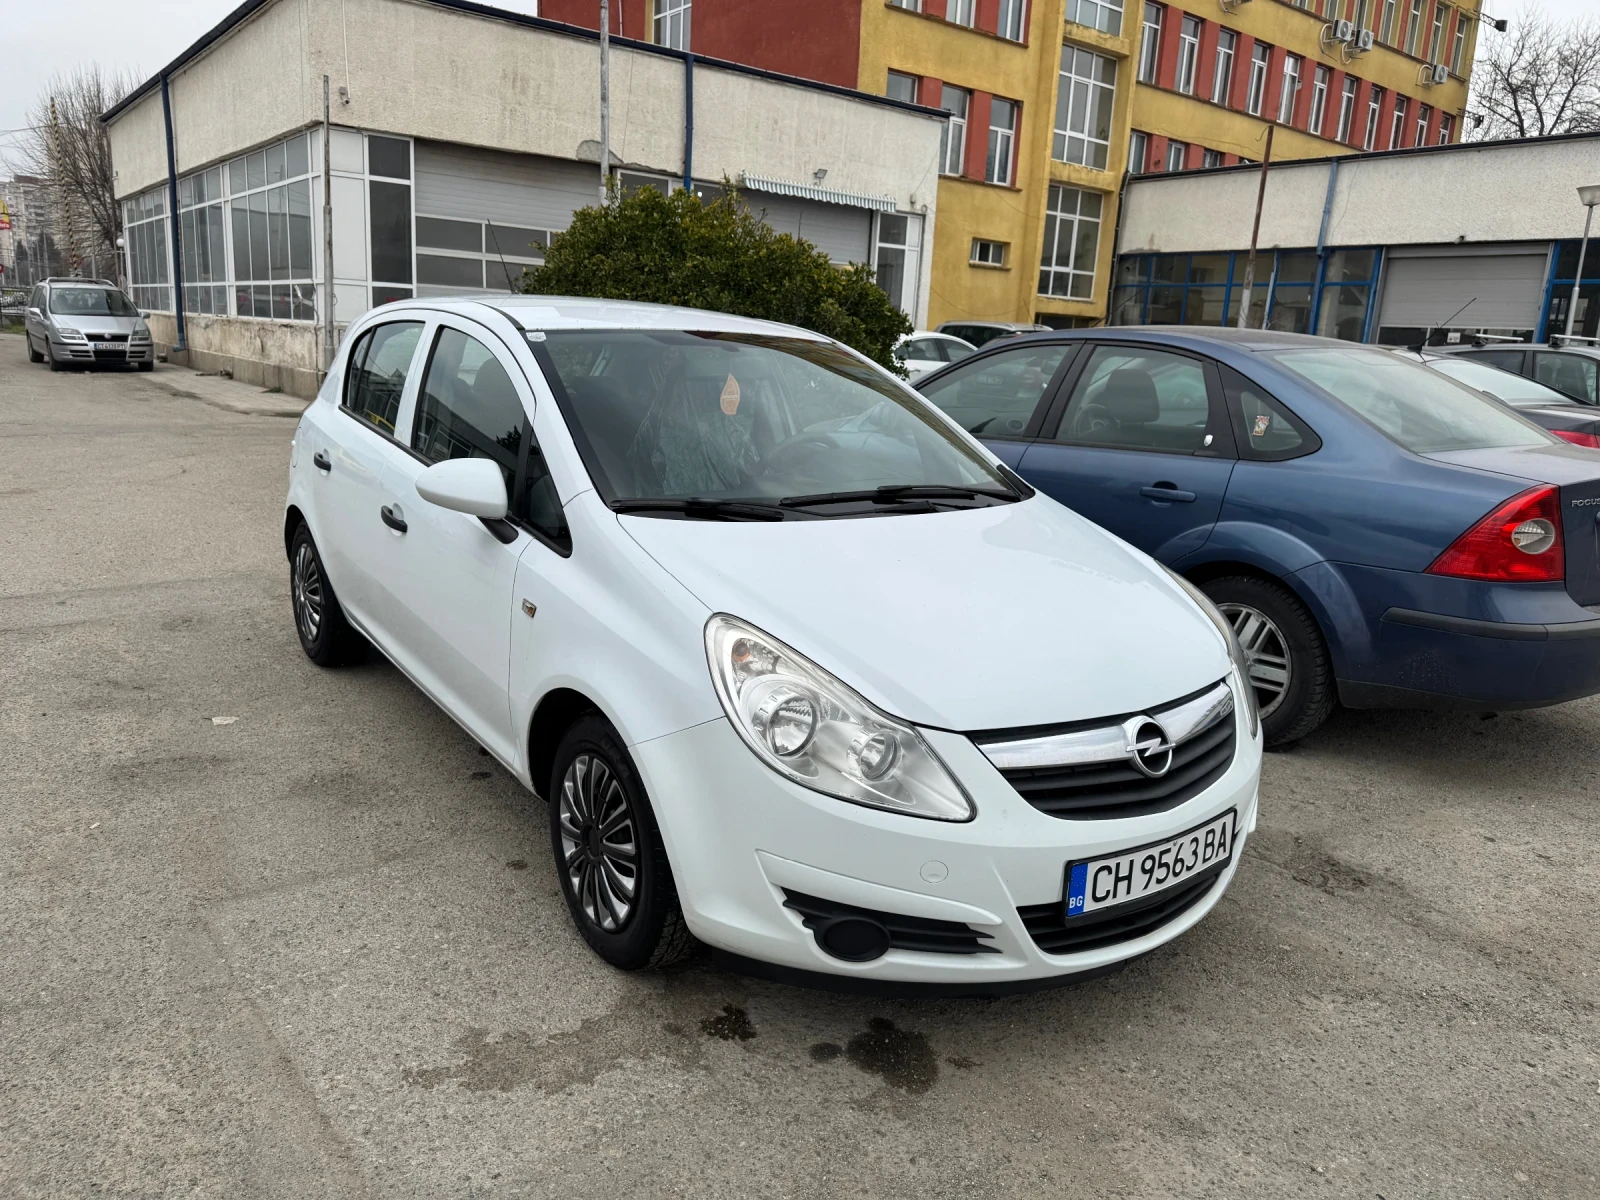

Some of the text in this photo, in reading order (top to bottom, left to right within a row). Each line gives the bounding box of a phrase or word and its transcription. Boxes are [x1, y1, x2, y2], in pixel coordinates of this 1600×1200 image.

[1571, 498, 1600, 507] FOCUS
[1092, 821, 1227, 903] CH 9563 BA
[1069, 895, 1083, 909] BG
